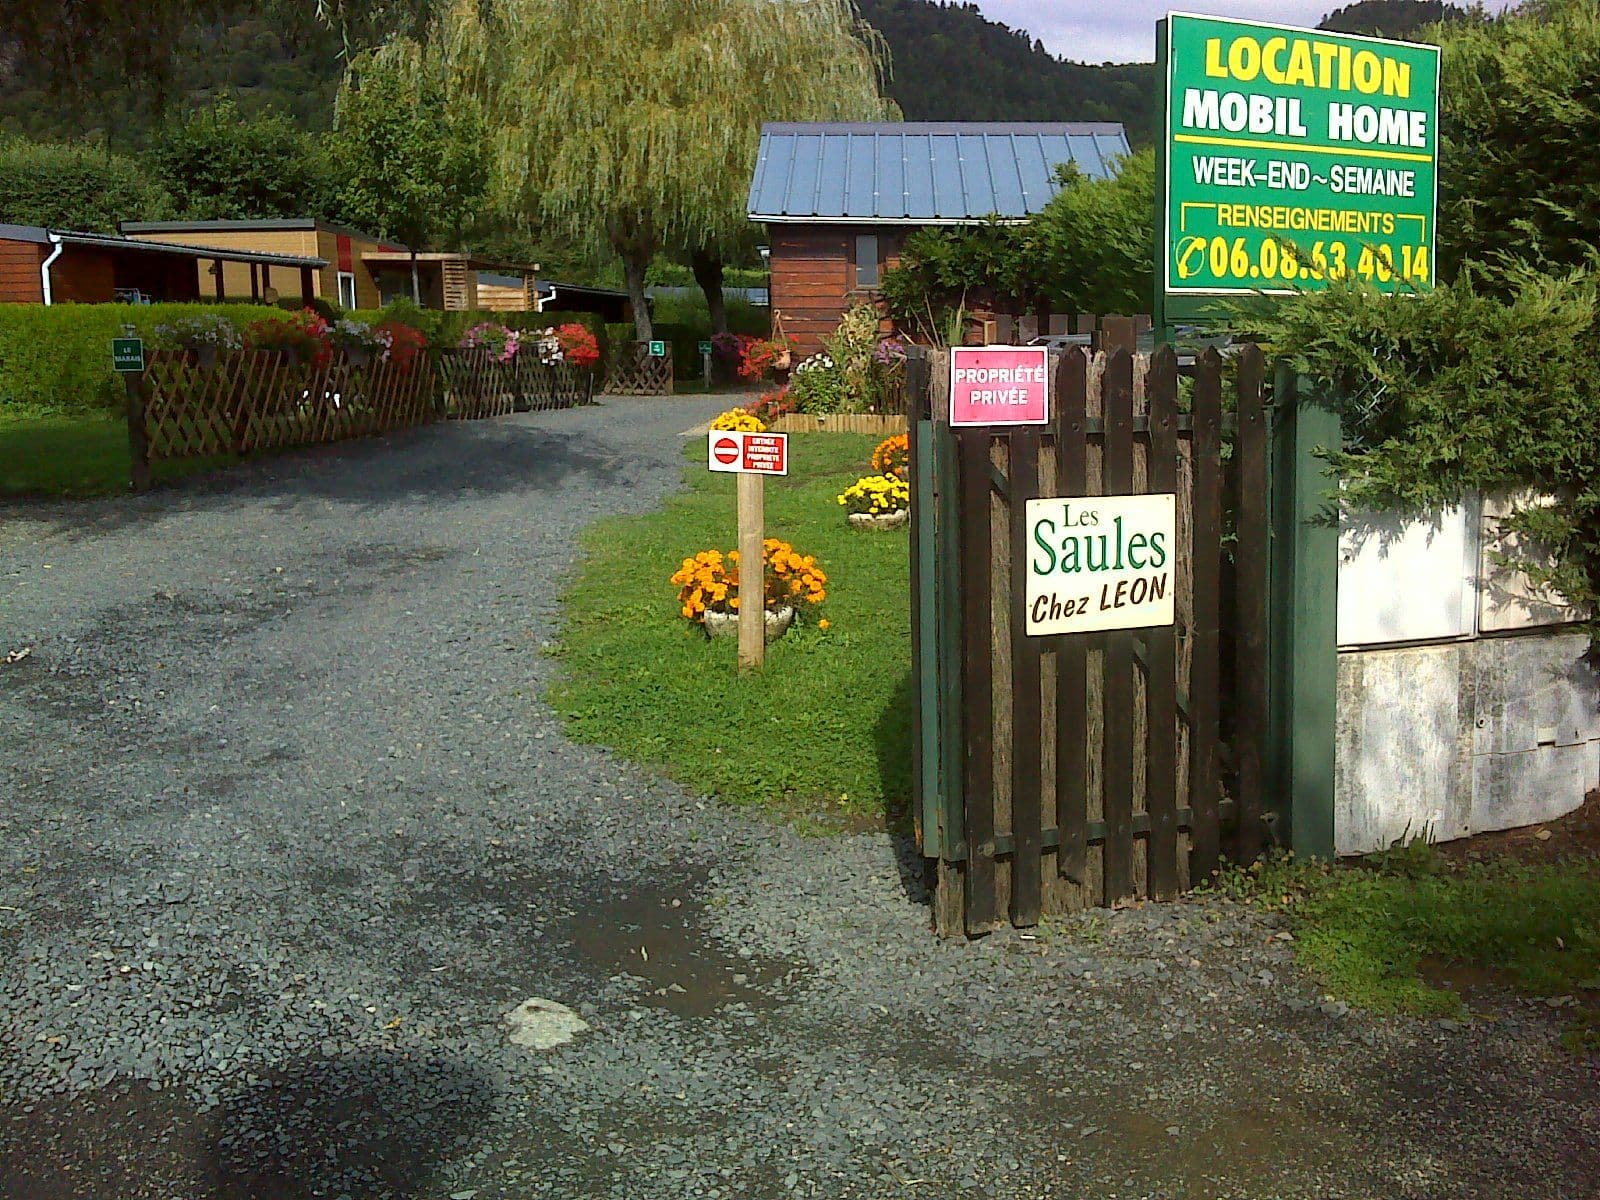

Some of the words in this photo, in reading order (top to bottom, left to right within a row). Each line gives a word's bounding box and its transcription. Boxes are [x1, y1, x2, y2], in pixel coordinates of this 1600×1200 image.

[1205, 36, 1410, 99] LOCATION
[1182, 88, 1307, 137] MOBIL
[1328, 102, 1427, 148] HOME
[1217, 203, 1395, 234] RENSEIGNEMENTS
[955, 365, 1045, 385] PROPRIÉTÉ
[970, 386, 1028, 406] PRIVÉE
[1063, 504, 1099, 527] Les
[1033, 515, 1166, 576] Saules
[1031, 592, 1090, 624] Chez
[1100, 572, 1168, 611] LEON
